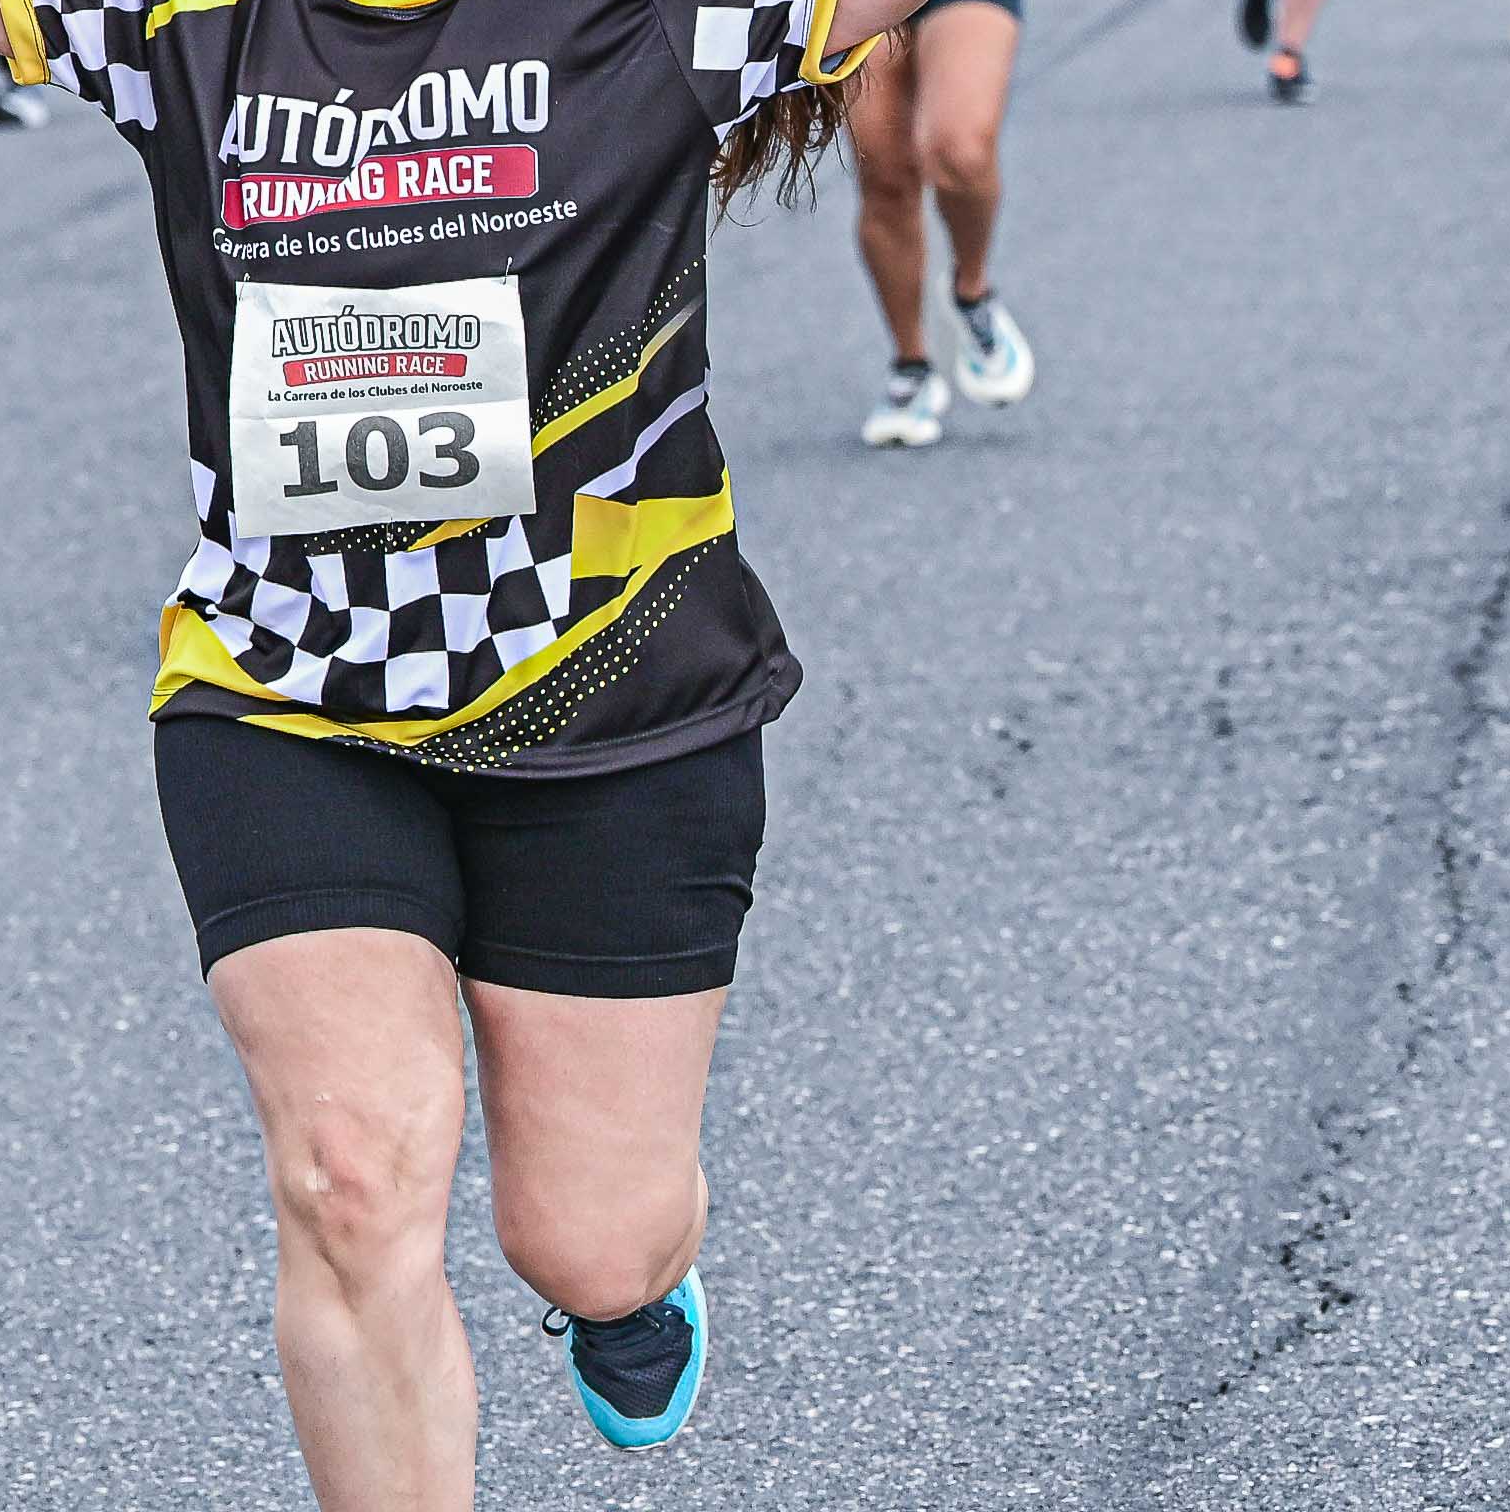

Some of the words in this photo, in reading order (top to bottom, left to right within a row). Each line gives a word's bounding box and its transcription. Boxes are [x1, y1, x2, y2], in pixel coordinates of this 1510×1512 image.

[240, 161, 385, 222] RUNNING
[397, 154, 495, 198] RACE
[274, 233, 303, 257] de
[307, 231, 341, 255] los
[345, 223, 425, 252] Clubes
[430, 214, 466, 241] del
[471, 199, 579, 235] Noroeste
[272, 304, 481, 357] AUTÓDROMO
[267, 390, 281, 402] La
[283, 389, 328, 402] Carrera
[330, 388, 346, 399] de
[348, 387, 366, 399] los
[367, 384, 408, 397] Clubes
[410, 382, 429, 394] del
[431, 379, 483, 394] Noroeste
[303, 355, 390, 383] RUNNING
[395, 355, 446, 376] RACE
[279, 411, 481, 498] 103
